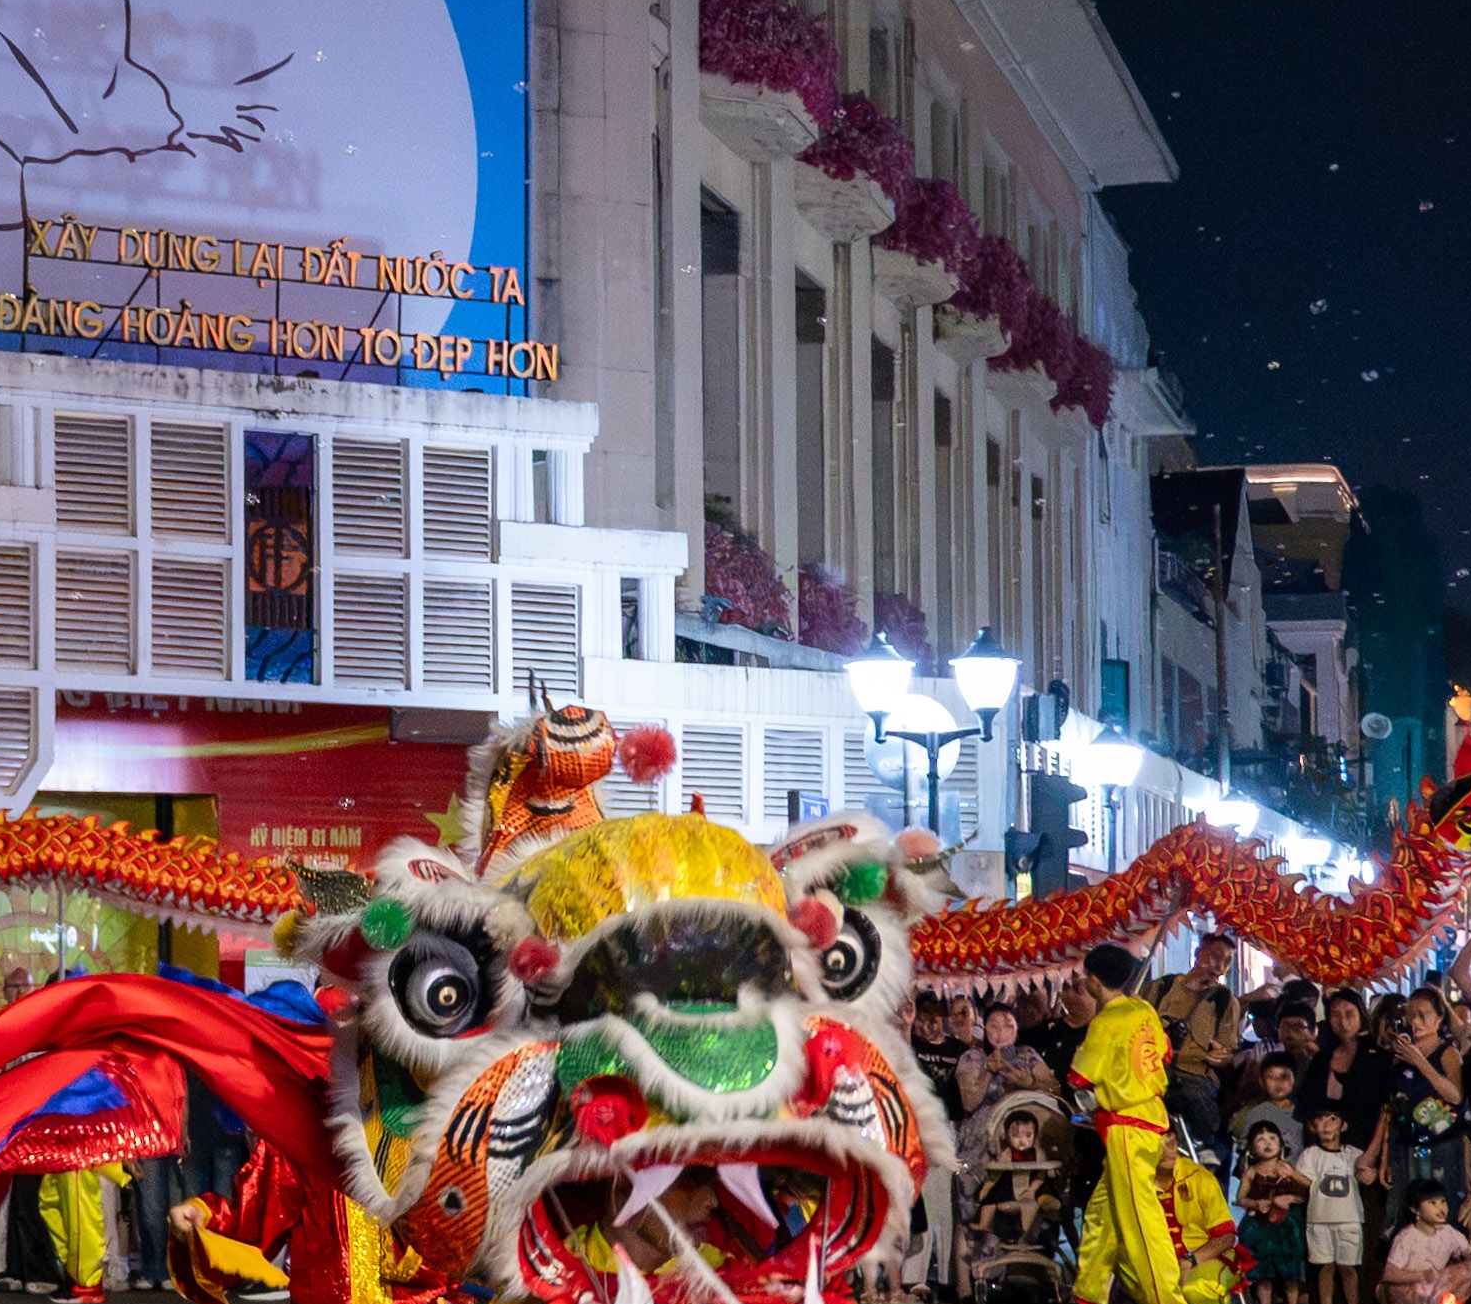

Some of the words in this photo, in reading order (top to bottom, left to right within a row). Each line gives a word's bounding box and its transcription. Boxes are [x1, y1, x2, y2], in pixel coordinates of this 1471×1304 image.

[28, 212, 98, 260] XÂY
[118, 227, 221, 277] DỰNG
[233, 239, 284, 288] LẠI
[300, 236, 361, 287] ĐẤT
[378, 250, 475, 299] NƯỚC
[489, 265, 525, 305] TA
[269, 317, 345, 362] HƠN
[360, 327, 402, 366] TO
[413, 332, 472, 381] ĐẸP
[487, 338, 558, 381] HƠN
